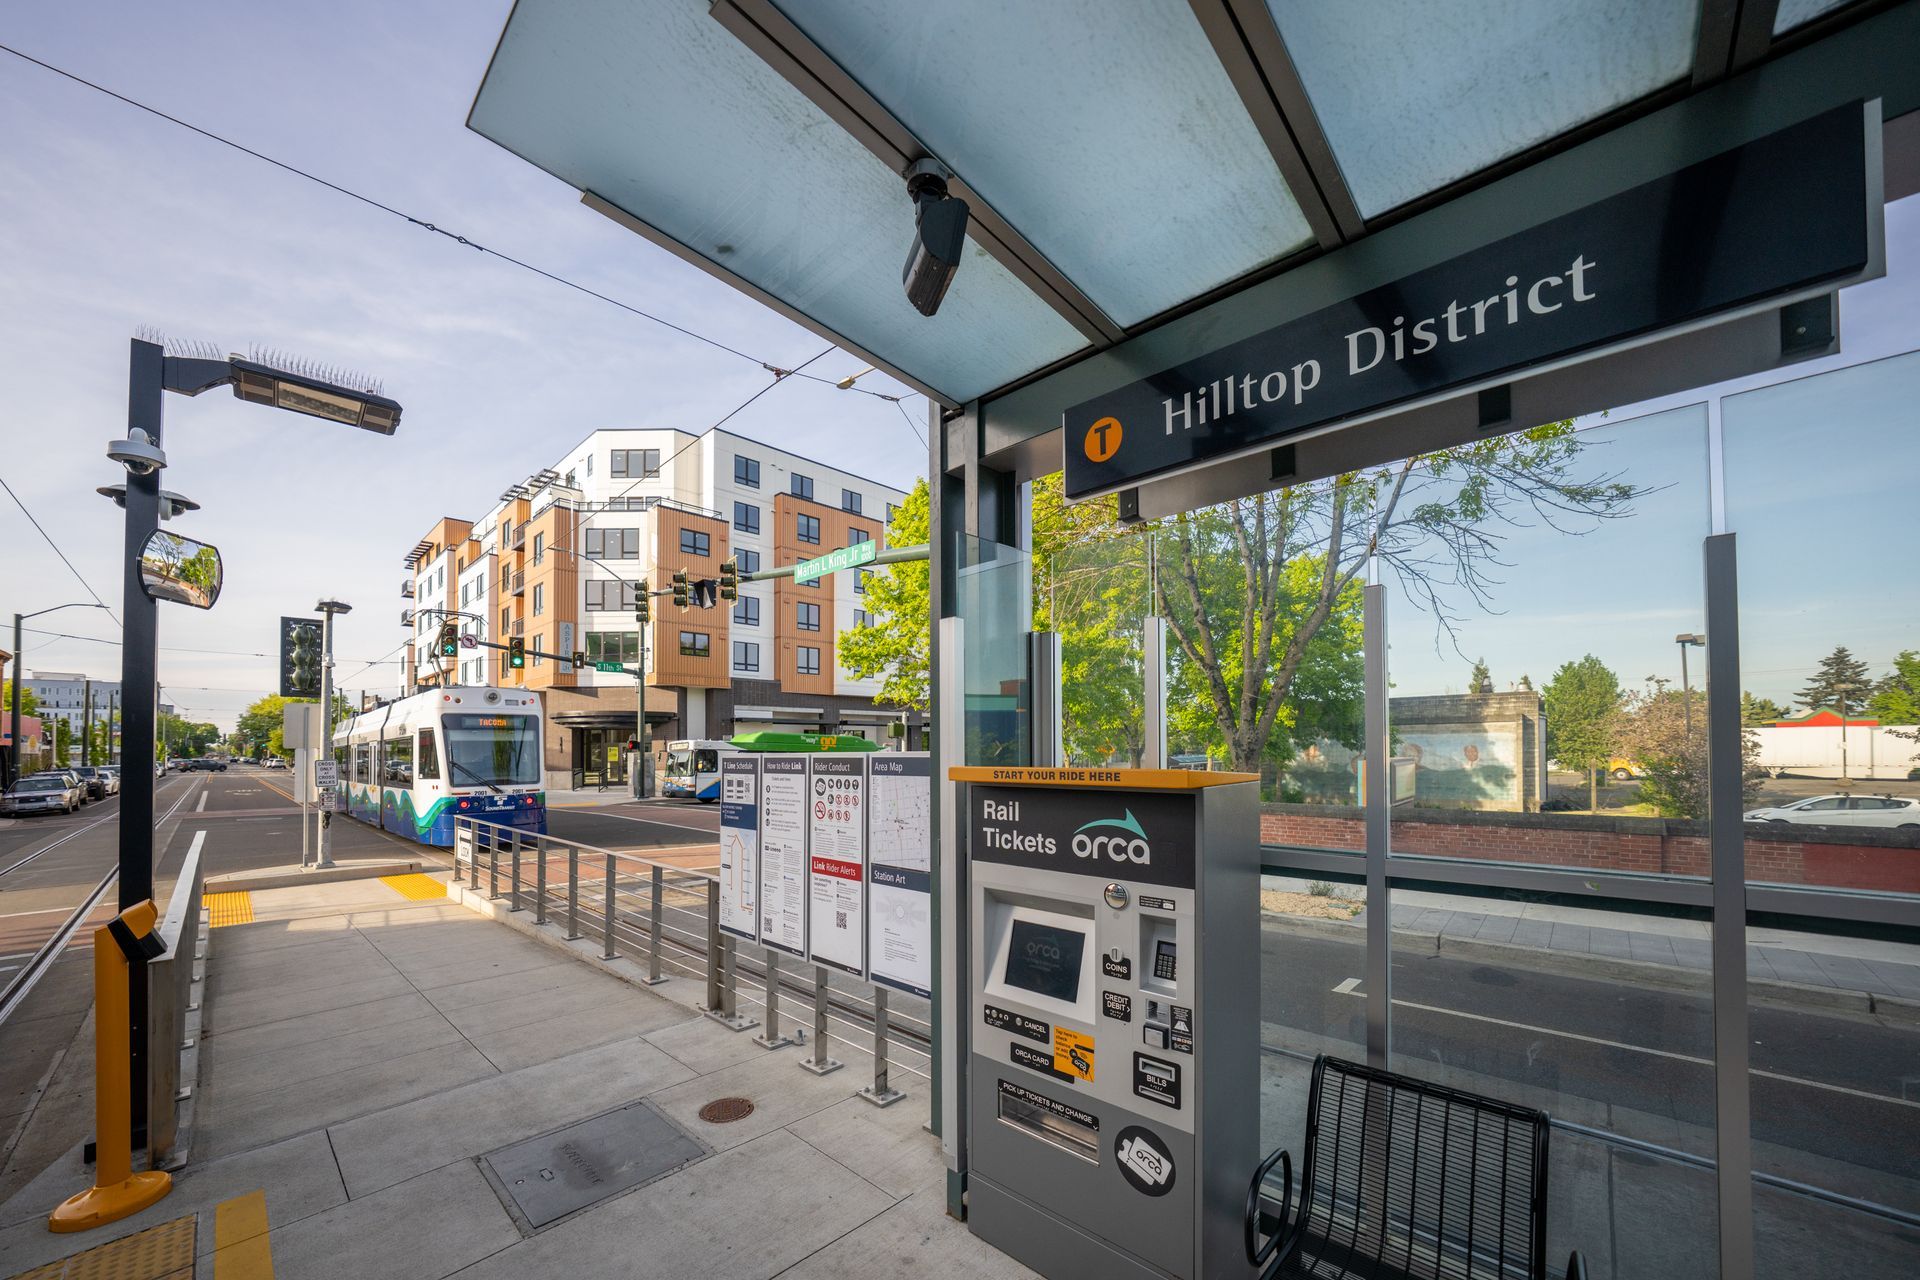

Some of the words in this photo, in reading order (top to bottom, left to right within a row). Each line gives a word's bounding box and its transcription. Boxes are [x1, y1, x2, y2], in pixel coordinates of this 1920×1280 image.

[1093, 423, 1112, 457] T
[1162, 357, 1322, 437] Hilltop
[1344, 254, 1597, 377] District
[862, 543, 871, 554] Way
[797, 562, 820, 578] Martin
[822, 557, 827, 571] L
[828, 553, 847, 569] King
[850, 548, 858, 562] Jr
[603, 663, 614, 671] 11th
[479, 718, 507, 727] TACOMA
[727, 762, 736, 770] Line
[736, 762, 753, 770] Schedule
[782, 762, 791, 770] Ride
[791, 762, 802, 770] Link
[814, 762, 828, 772] Rider
[828, 763, 851, 773] Conduct
[874, 762, 888, 772] Area
[889, 763, 903, 774] Map
[993, 770, 1024, 781] START
[1027, 772, 1056, 781] YOUR
[1059, 771, 1085, 782] RIDE
[1089, 771, 1121, 782] HERE
[983, 799, 1020, 822] Rail
[982, 827, 1057, 855] Tickets
[1071, 833, 1151, 865] orca
[813, 860, 826, 871] Link
[826, 863, 841, 874] Rider
[840, 866, 856, 877] Alerts
[874, 870, 895, 883] Station
[896, 875, 906, 885] Art
[1027, 942, 1060, 959] orca
[1105, 963, 1128, 974] COINS
[1104, 992, 1129, 1005] CREDIT
[1106, 1001, 1126, 1011] DEBIT
[1024, 1020, 1046, 1034] CANCEL
[1015, 1048, 1031, 1059] ORCA
[1032, 1054, 1049, 1066] CARD
[1074, 1060, 1087, 1071] orca
[1146, 1074, 1167, 1087] BILLS
[1003, 1082, 1016, 1093] PICK
[1016, 1088, 1025, 1096] UP
[1025, 1091, 1050, 1107] TICKETS
[1051, 1101, 1065, 1112] AND
[1065, 1106, 1093, 1124] CHANGE
[1136, 1150, 1162, 1175] orca
